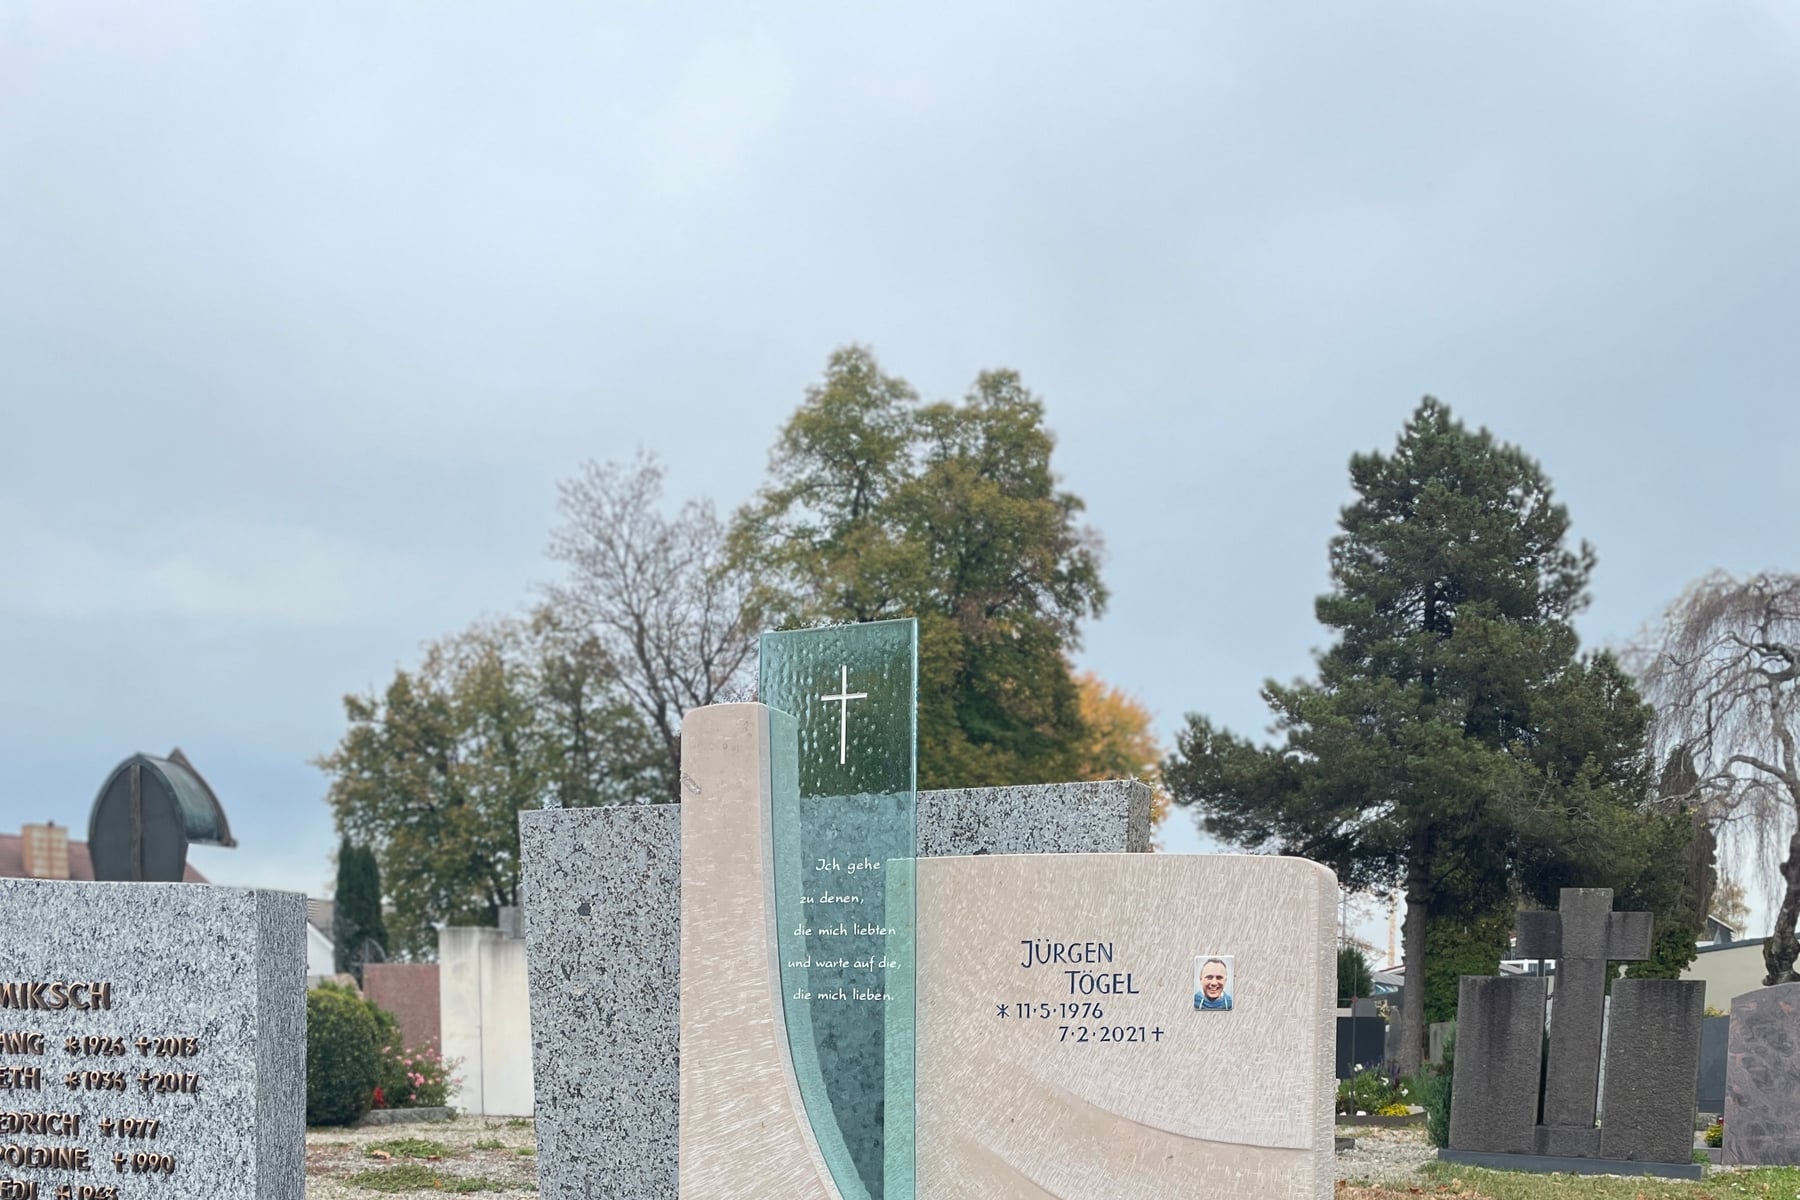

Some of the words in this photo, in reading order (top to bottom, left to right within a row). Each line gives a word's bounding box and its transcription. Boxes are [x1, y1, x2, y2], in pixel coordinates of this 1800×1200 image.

[815, 858, 840, 871] Ich
[847, 857, 881, 874] gehe
[799, 896, 814, 904] zu
[819, 891, 864, 904] denen,
[793, 923, 813, 936] die
[818, 923, 848, 936] mich
[853, 923, 896, 936] liebten
[1021, 938, 1113, 968] JÜRGEN
[788, 956, 811, 968] und
[815, 958, 850, 968] warte
[853, 955, 876, 972] auf
[878, 956, 901, 970] die,
[1064, 970, 1140, 995] TÖGEL
[0, 981, 111, 1011] MIKSCH
[793, 988, 812, 1000] die
[817, 987, 847, 1001] mich
[852, 988, 895, 1001] lieben.
